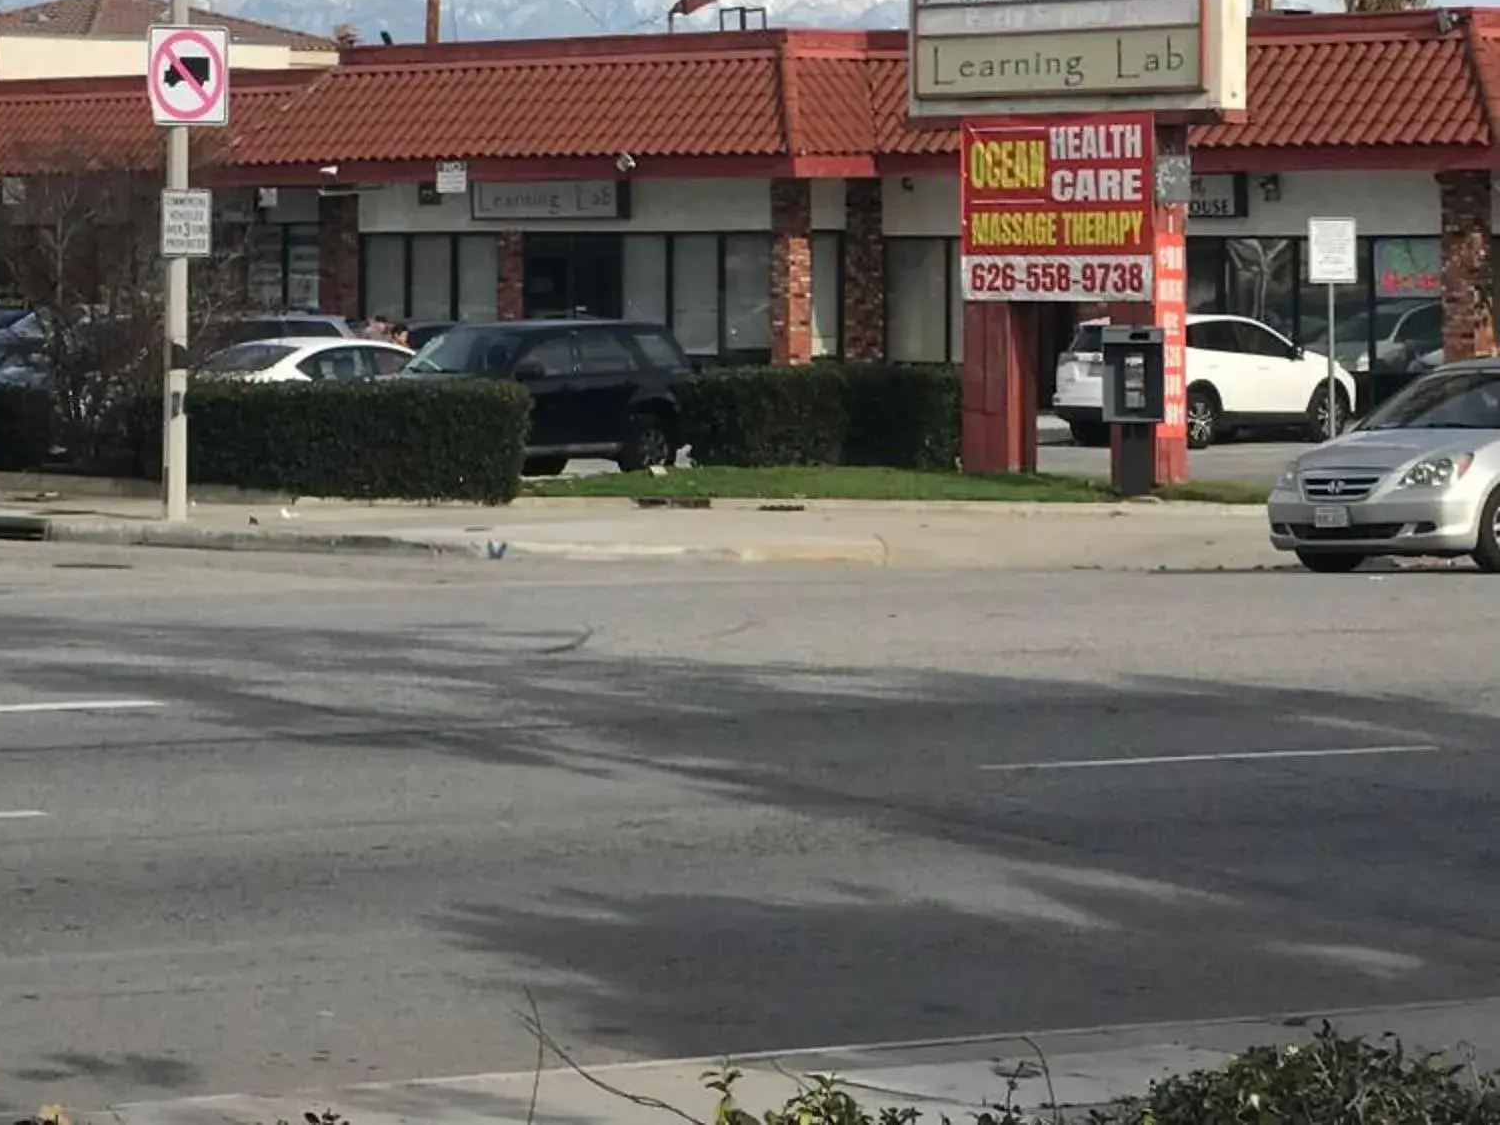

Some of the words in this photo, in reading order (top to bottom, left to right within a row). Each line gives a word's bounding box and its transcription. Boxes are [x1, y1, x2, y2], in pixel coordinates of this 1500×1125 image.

[933, 45, 1085, 87] Learning
[1116, 35, 1185, 79] Lab
[1050, 124, 1143, 161] HEALTH
[970, 140, 1045, 189] OCEAN
[1051, 168, 1143, 202] CARE
[1189, 199, 1229, 214] OUSE
[971, 211, 1057, 246] MASSAGE
[1061, 210, 1143, 246] THERAPY
[971, 261, 1143, 293] 626-558-9738
